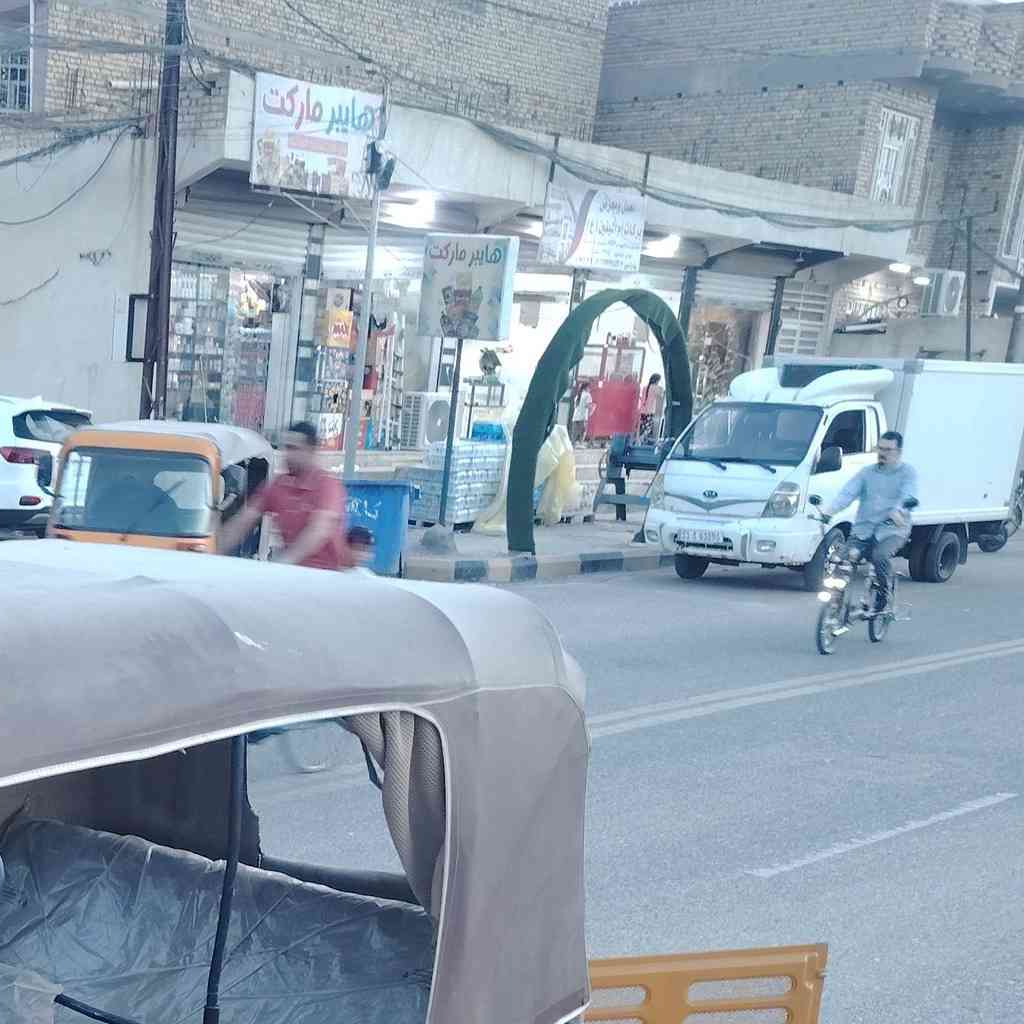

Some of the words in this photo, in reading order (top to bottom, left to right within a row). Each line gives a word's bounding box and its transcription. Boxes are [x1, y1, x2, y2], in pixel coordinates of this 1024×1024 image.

[262, 85, 323, 130] ماركت
[326, 95, 375, 135] هايبر
[429, 242, 466, 266] ماركت
[468, 245, 502, 268] هايبر
